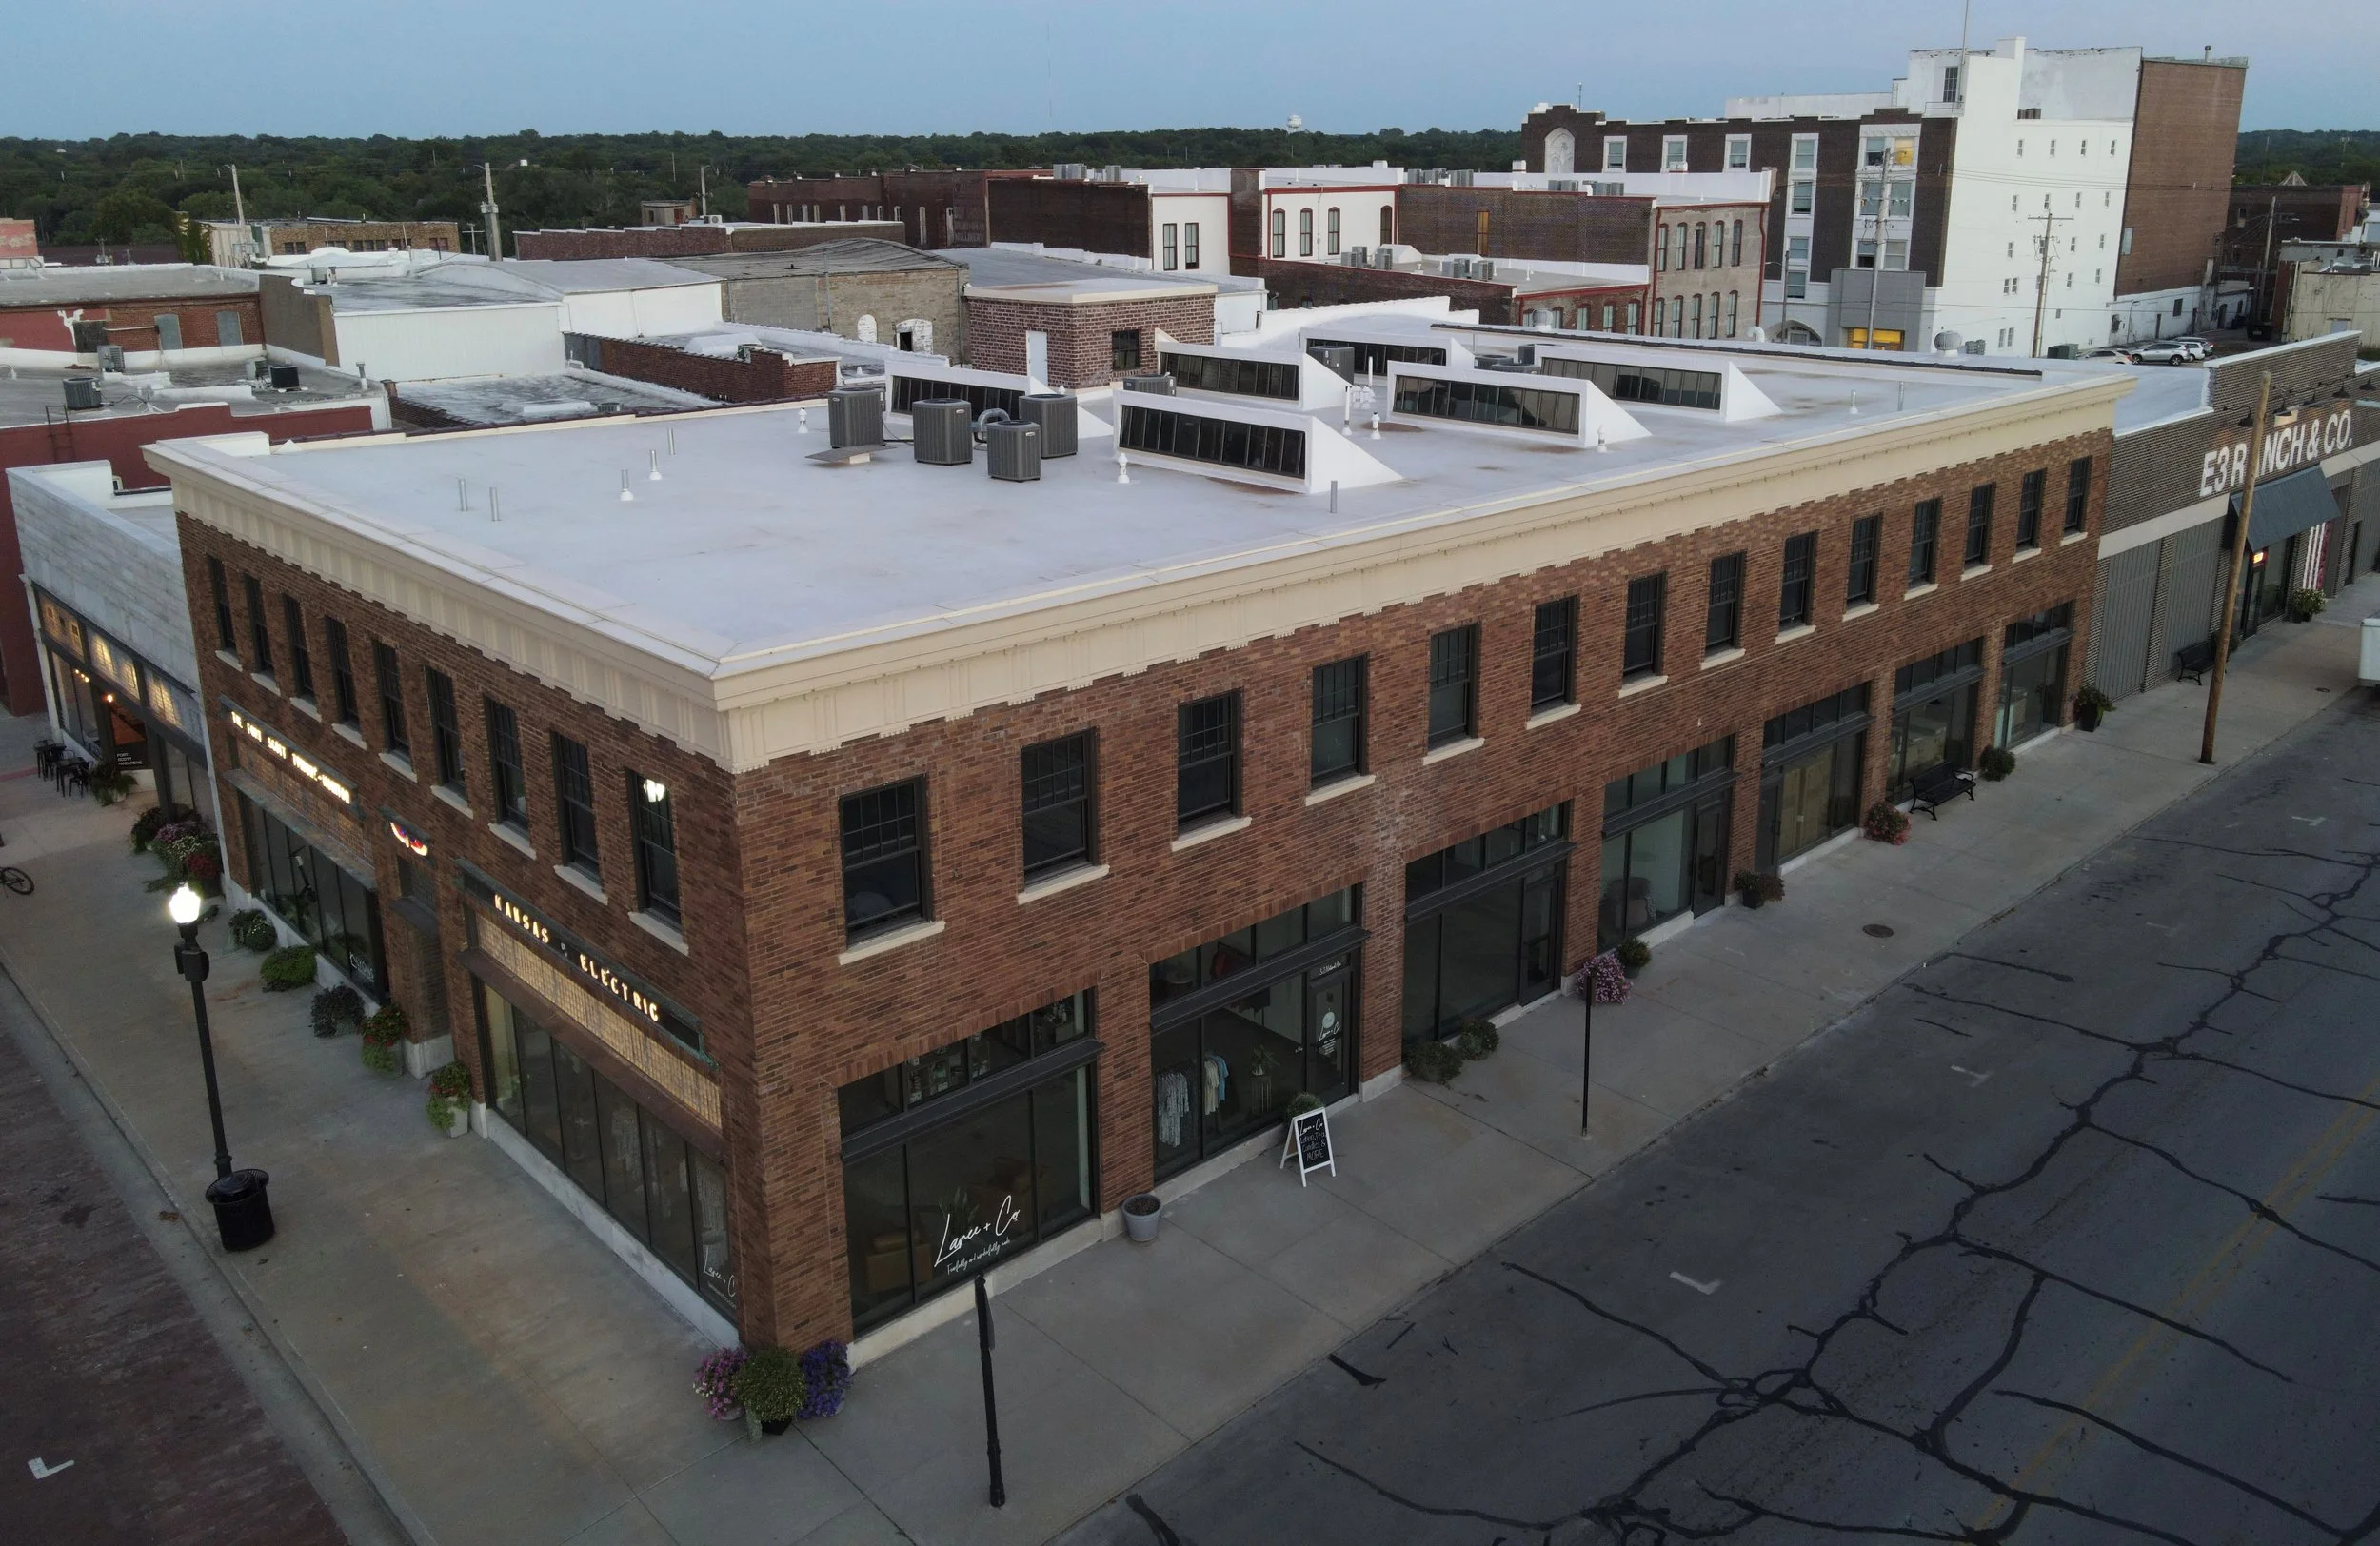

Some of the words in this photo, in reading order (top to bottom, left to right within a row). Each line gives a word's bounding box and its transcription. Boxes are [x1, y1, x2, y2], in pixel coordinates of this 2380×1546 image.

[2200, 446, 2230, 497] E3
[2230, 424, 2306, 486] RNCH
[2307, 419, 2321, 461] &
[2324, 410, 2353, 455] CO.
[494, 894, 549, 944] KANSAS
[579, 953, 660, 1022] ELECTRIC
[1307, 1148, 1324, 1161] MORE
[727, 1274, 737, 1298] C
